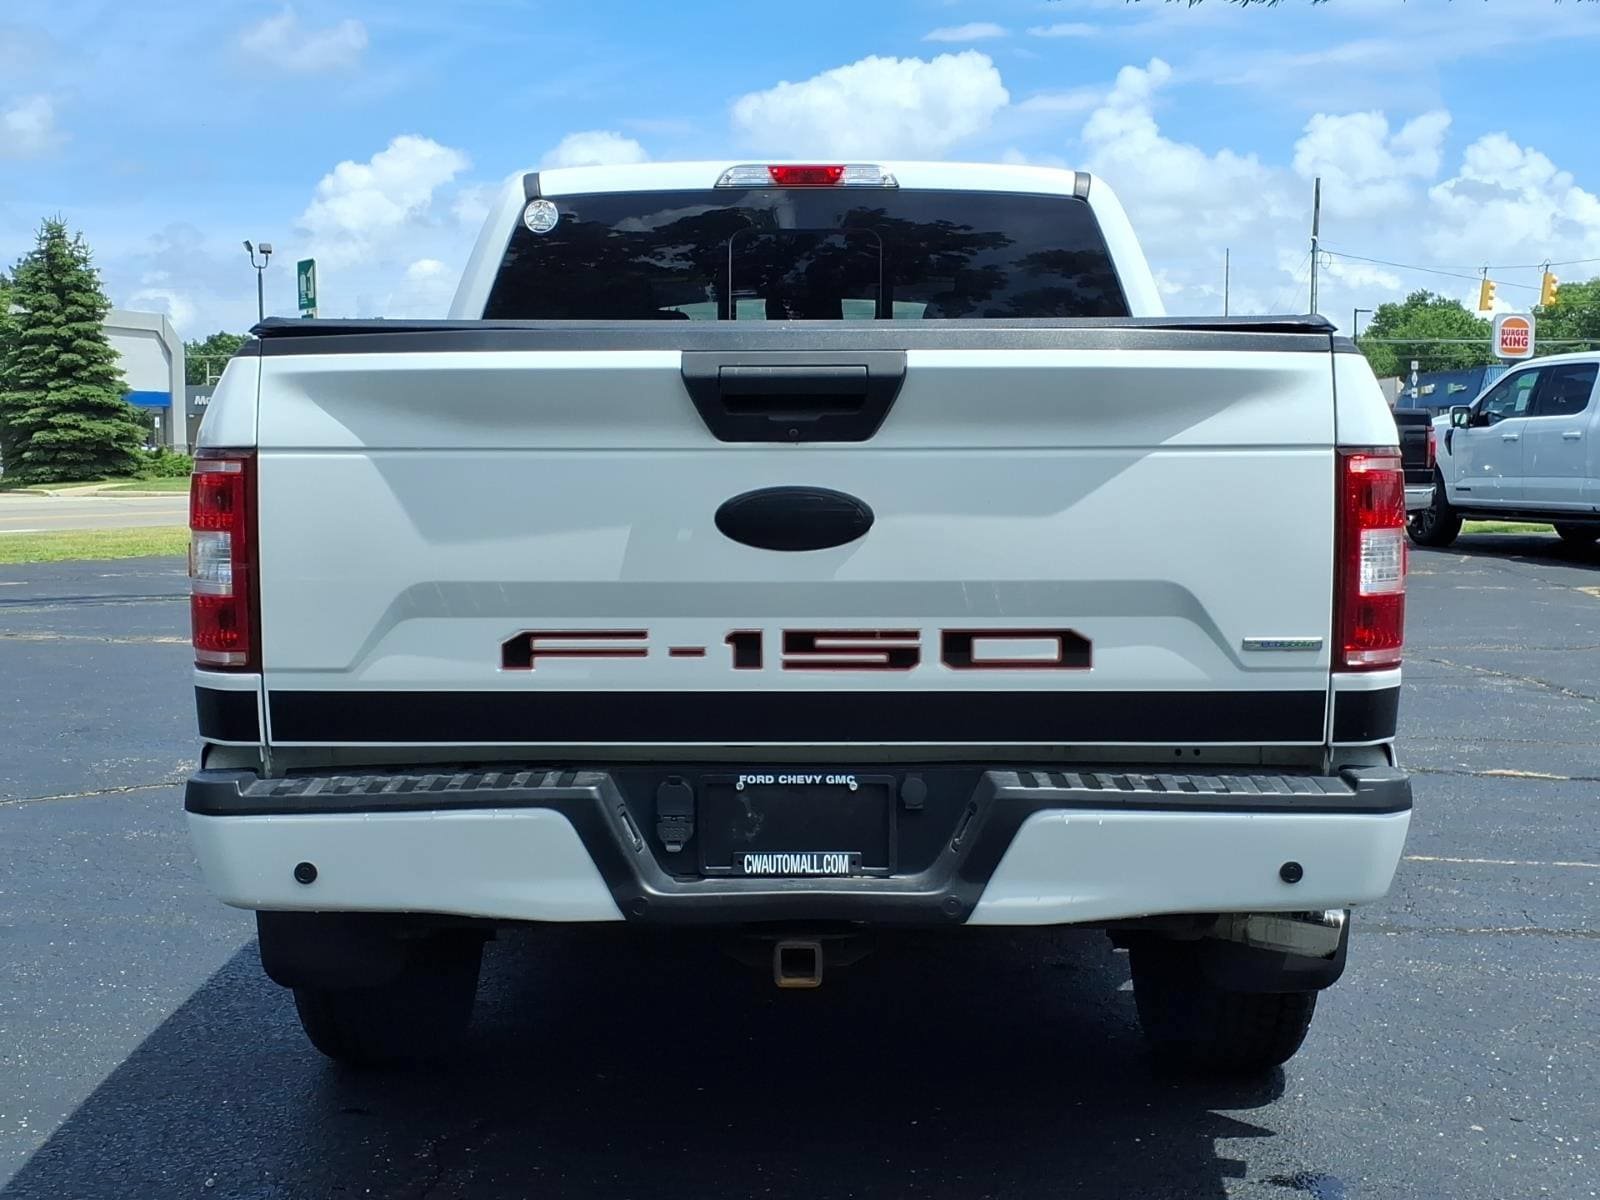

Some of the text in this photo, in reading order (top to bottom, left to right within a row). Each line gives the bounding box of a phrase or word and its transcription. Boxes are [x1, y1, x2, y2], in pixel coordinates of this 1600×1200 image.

[1501, 337, 1529, 347] KING
[499, 628, 1093, 671] F-150
[738, 774, 856, 785] FORD CHEVY GMC
[743, 854, 849, 874] CWAUTOMALL.COM
